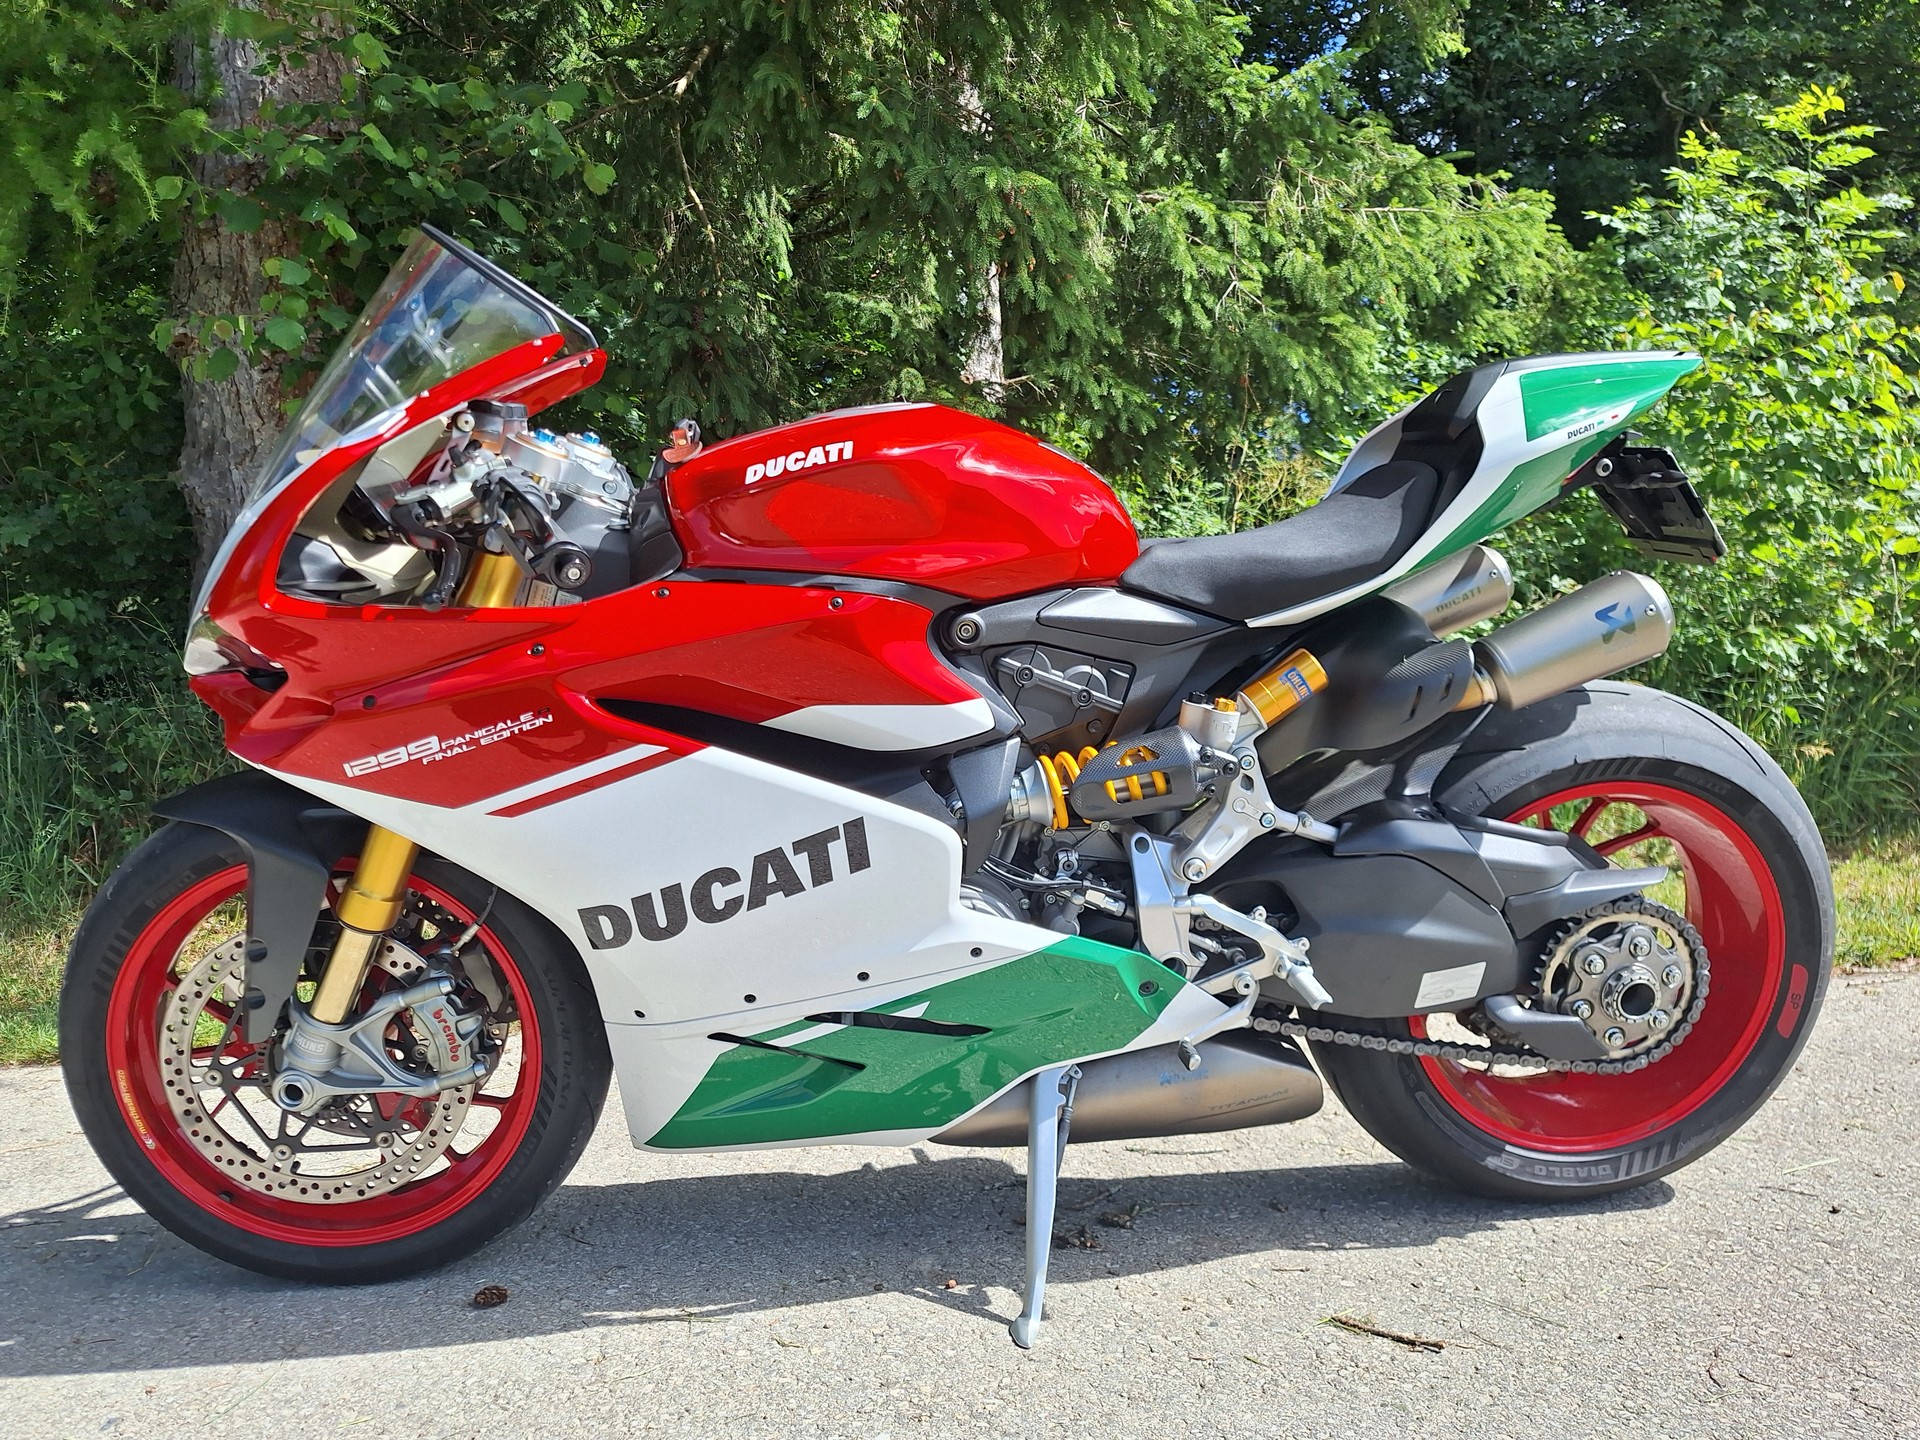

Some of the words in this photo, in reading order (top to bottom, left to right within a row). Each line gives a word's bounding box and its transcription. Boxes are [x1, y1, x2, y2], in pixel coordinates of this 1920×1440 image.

[1567, 422, 1595, 439] DUCATI
[744, 440, 854, 485] DUCATI
[1436, 586, 1482, 612] DUCATI
[342, 734, 441, 778] 1299
[441, 711, 535, 749] PANIGALE
[422, 745, 477, 765] FINAL
[480, 714, 554, 746] EDITION
[576, 815, 872, 951] DUCATI
[1790, 992, 1802, 1010] SP
[432, 1007, 462, 1063] brembo
[1208, 1087, 1290, 1112] TITANIUM
[1533, 1163, 1613, 1177] DIABLO
